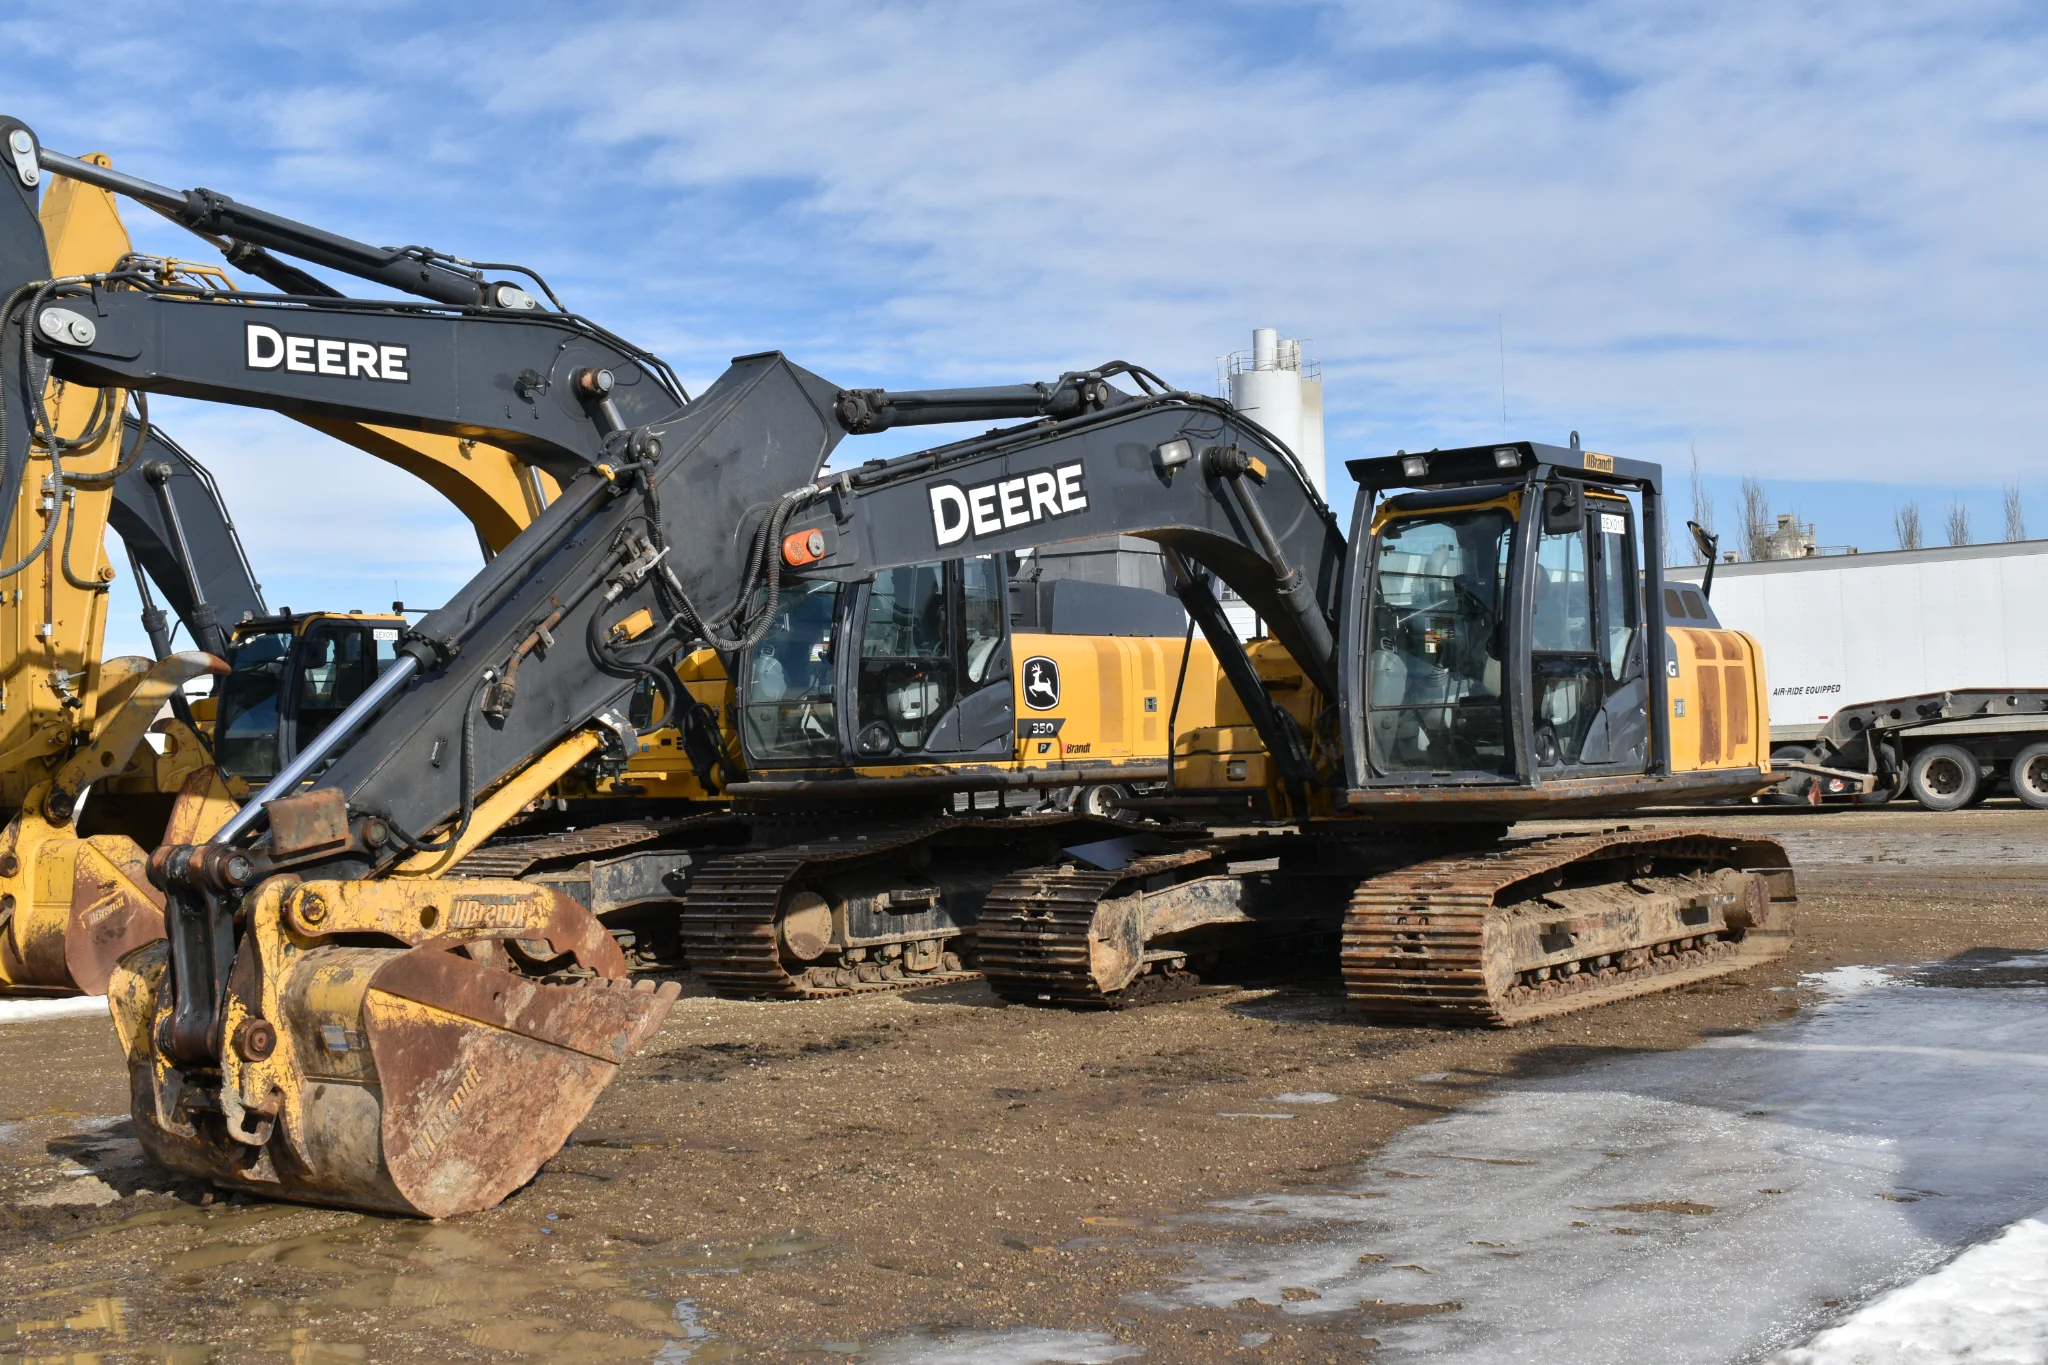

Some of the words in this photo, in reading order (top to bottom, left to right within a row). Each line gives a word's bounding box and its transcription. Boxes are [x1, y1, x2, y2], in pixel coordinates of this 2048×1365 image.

[247, 324, 409, 381] DEERE
[929, 463, 1087, 547] DEERE
[1773, 686, 1804, 696] AIR-RIDE
[1805, 684, 1841, 695] EQUIPPED
[1032, 722, 1054, 734] 350
[1065, 742, 1091, 754] Brandt
